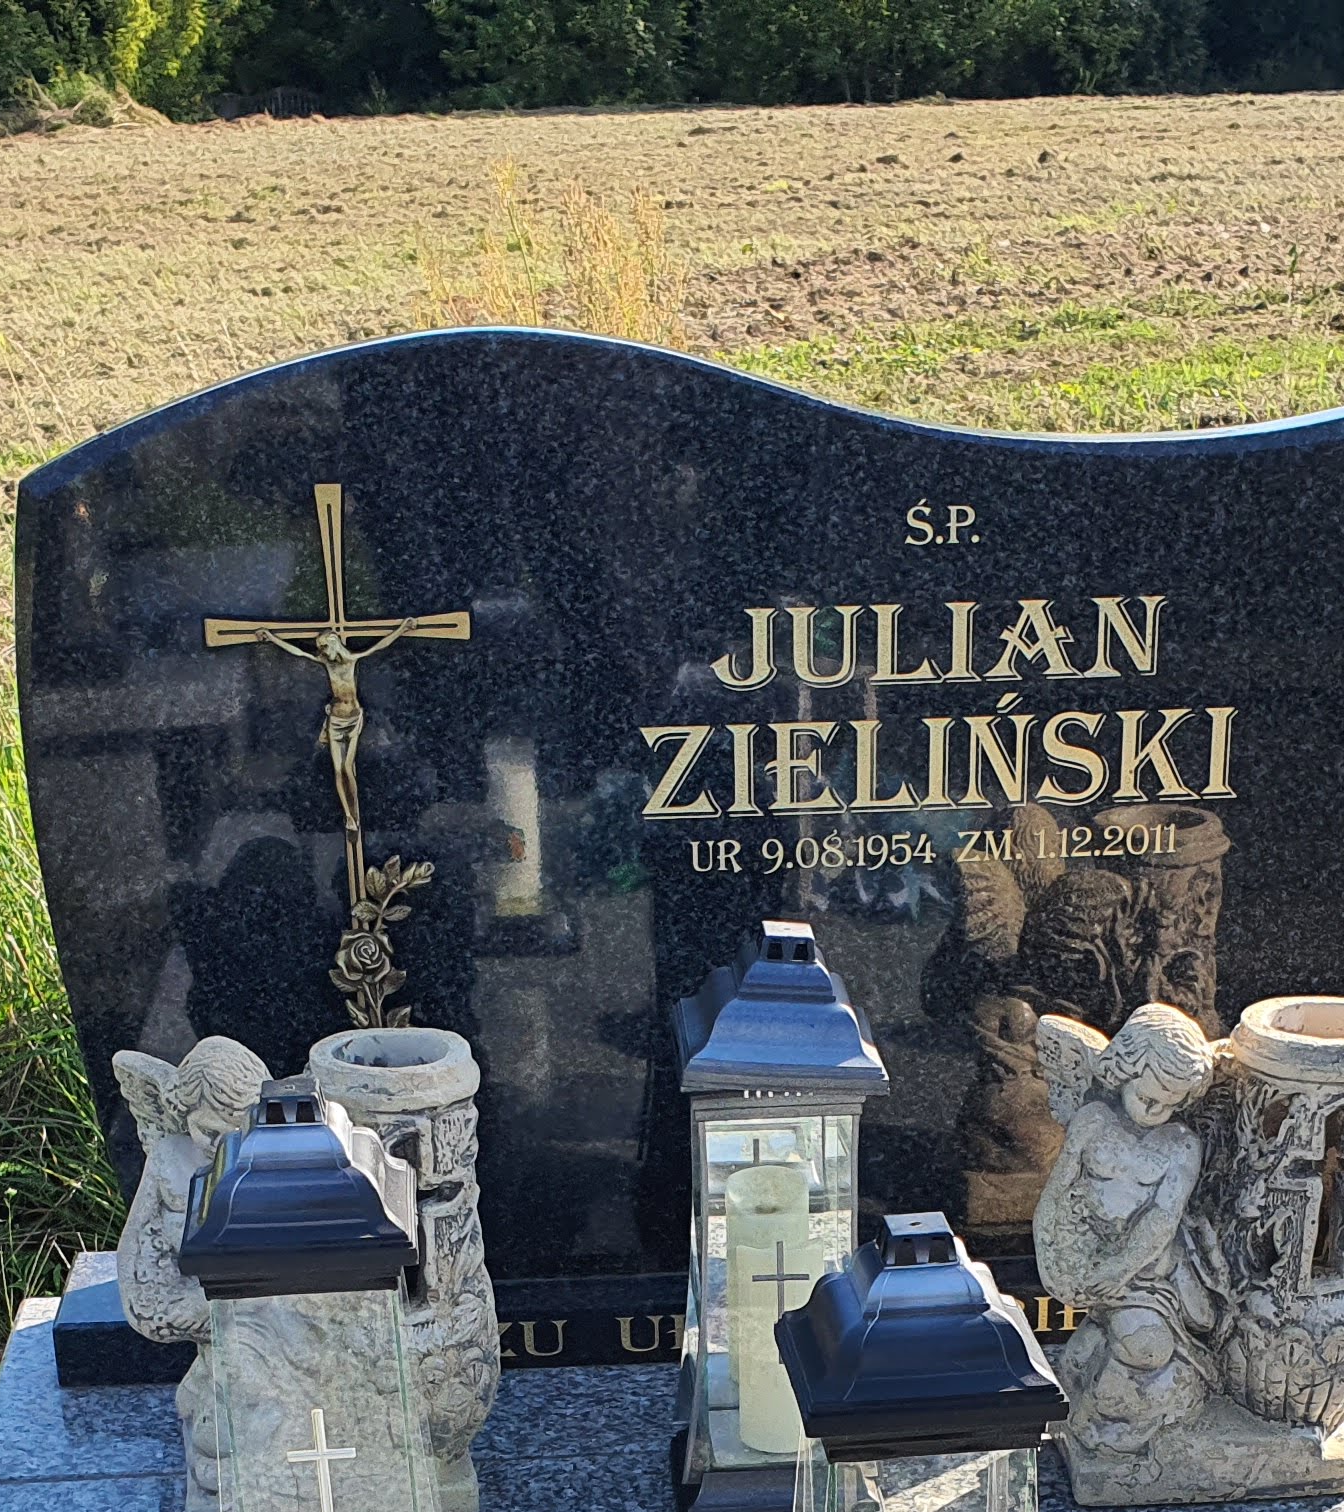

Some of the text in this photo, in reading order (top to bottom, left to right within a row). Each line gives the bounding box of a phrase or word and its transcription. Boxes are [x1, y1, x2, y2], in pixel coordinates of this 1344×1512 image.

[904, 499, 981, 547] Ś.P.
[709, 595, 1167, 692] JULIAN
[639, 692, 1238, 821] ZIELIŃSKI
[690, 822, 1177, 875] UR 9.08.1954 ZM. 1.12.2011
